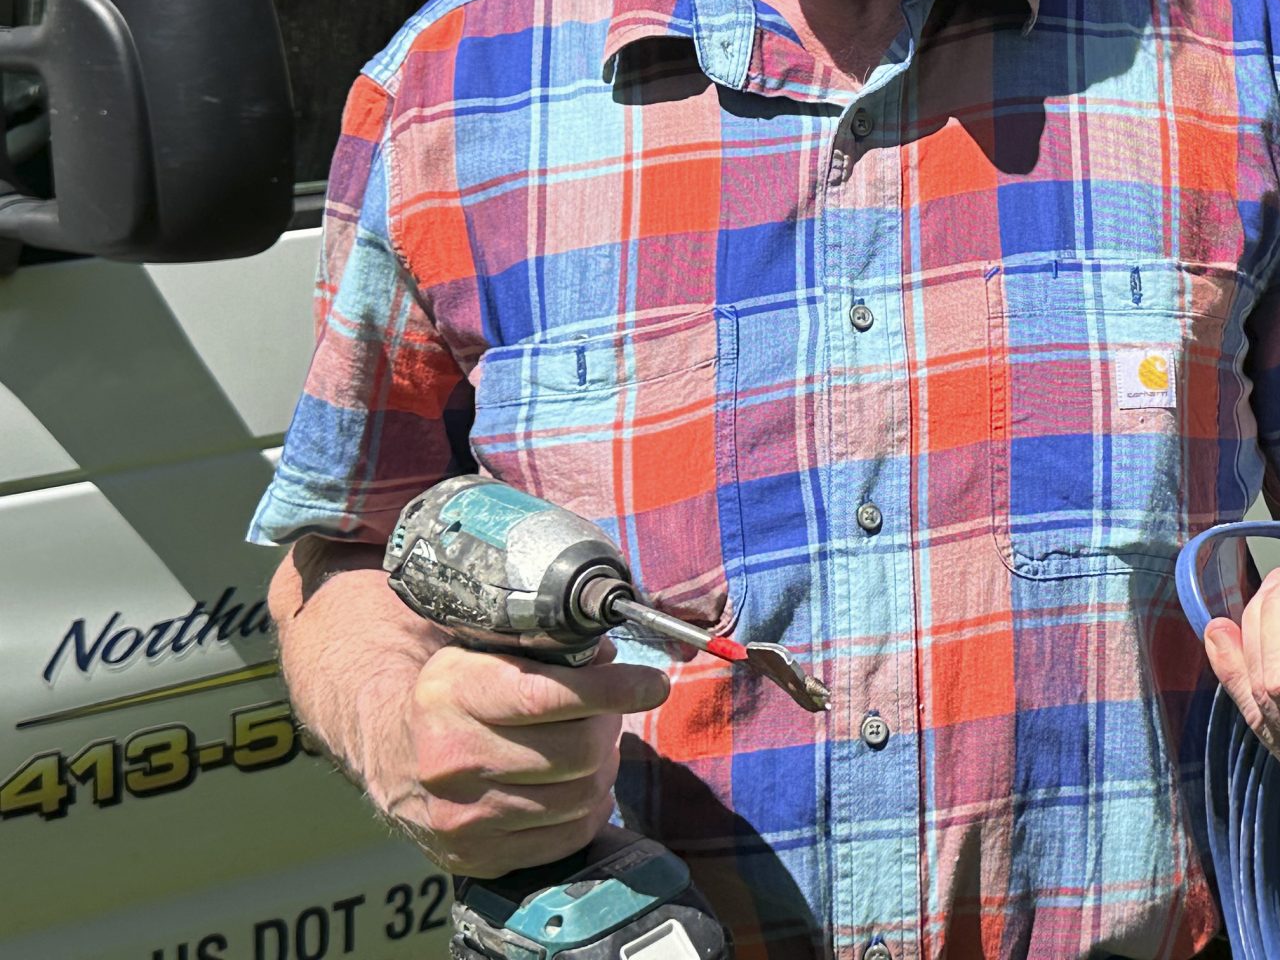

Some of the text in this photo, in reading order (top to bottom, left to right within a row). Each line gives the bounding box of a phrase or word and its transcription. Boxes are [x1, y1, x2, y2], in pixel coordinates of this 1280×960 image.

[0, 697, 314, 822] 413-5
[253, 894, 366, 960] DOT
[385, 873, 449, 941] 32
